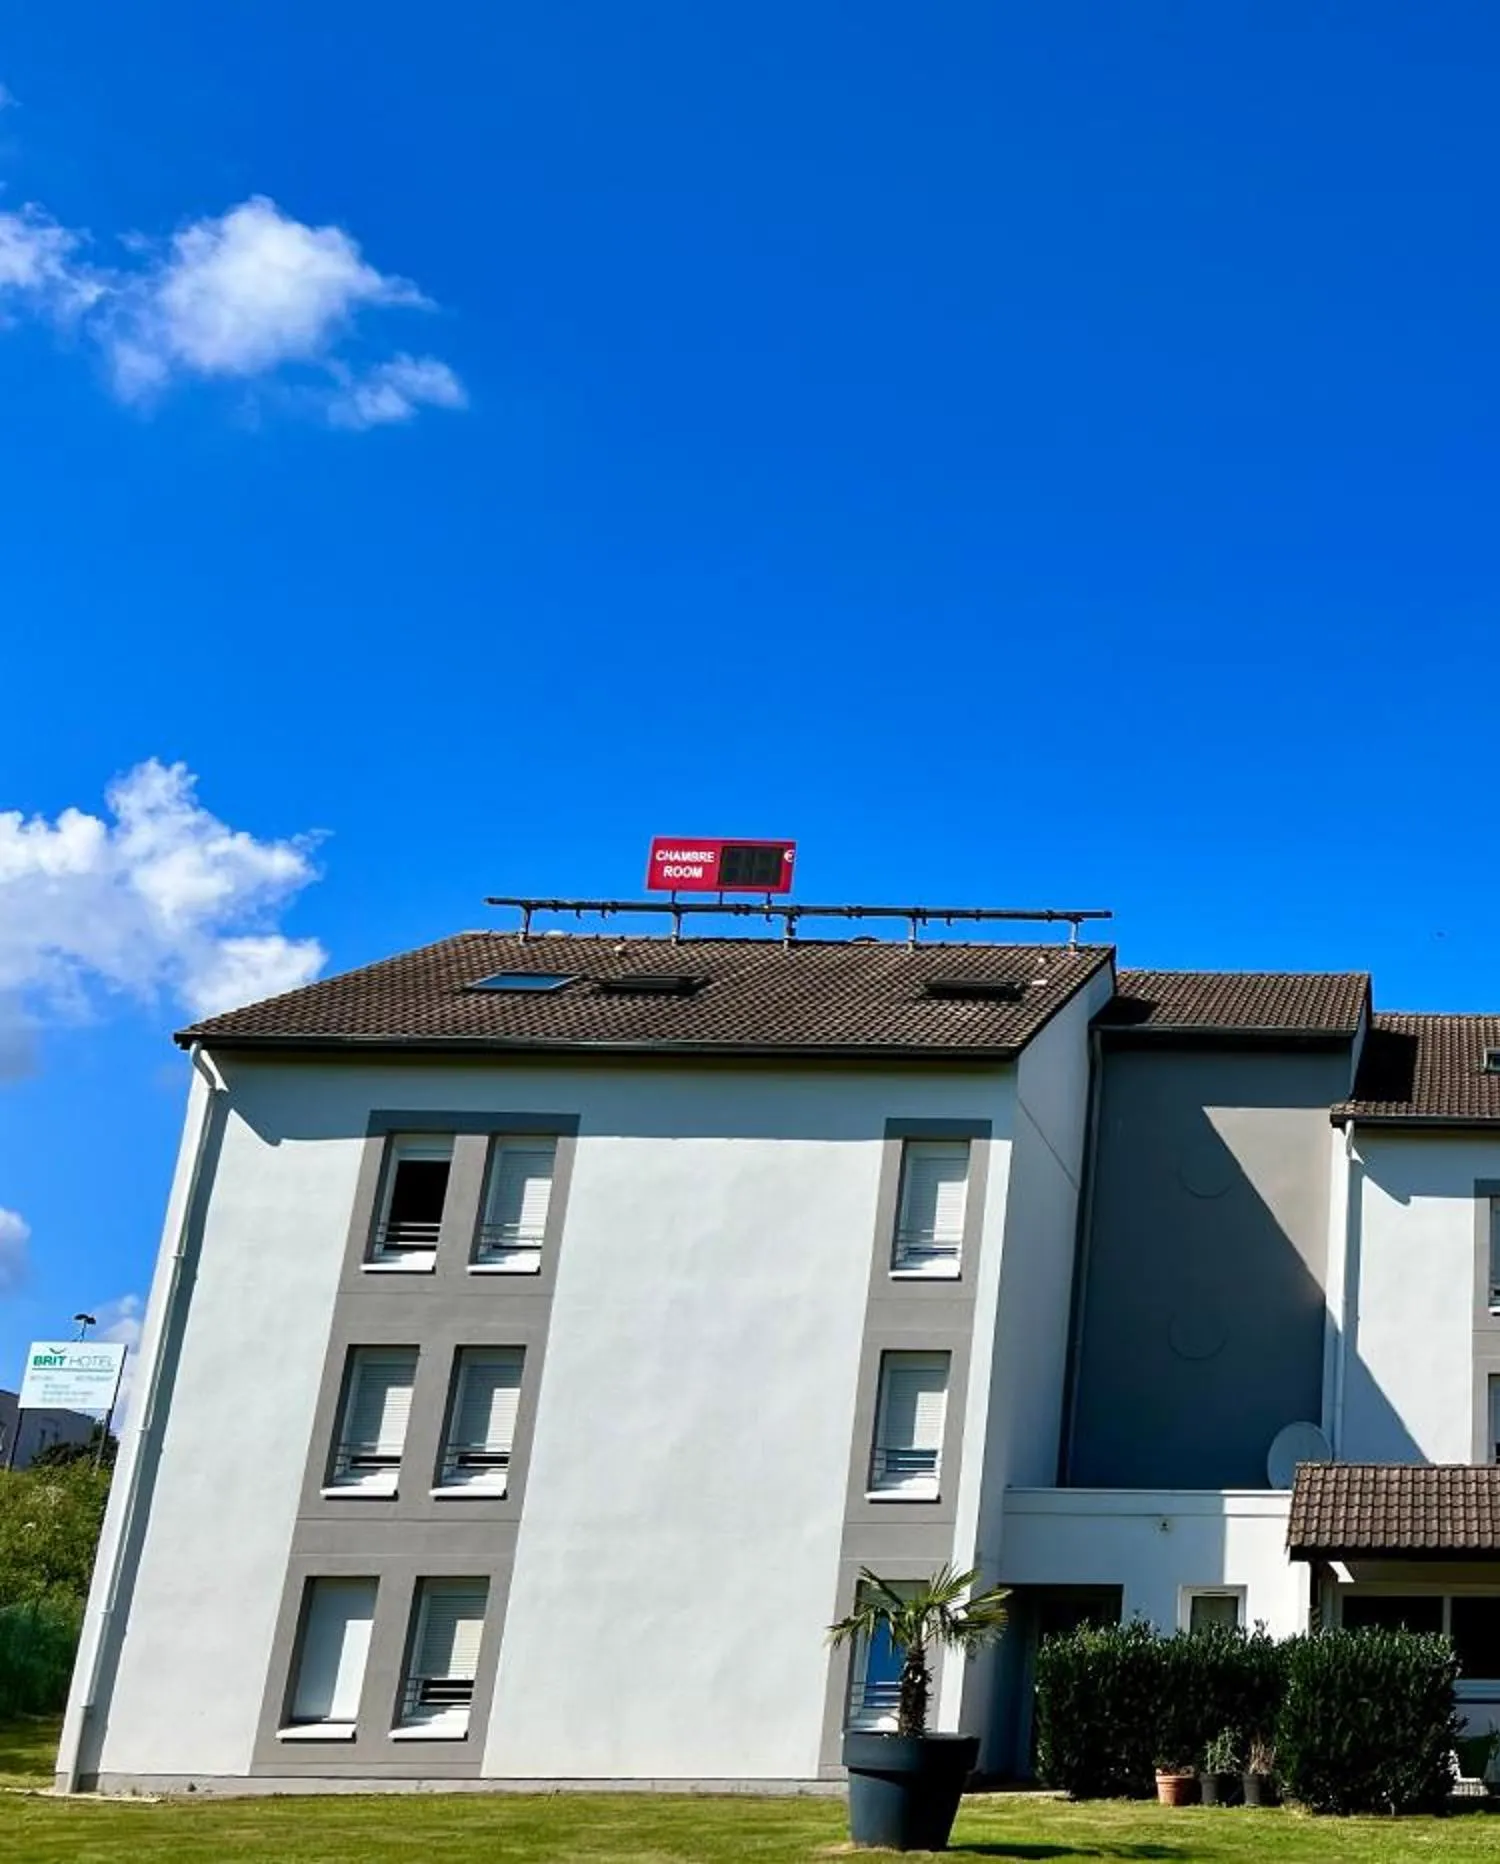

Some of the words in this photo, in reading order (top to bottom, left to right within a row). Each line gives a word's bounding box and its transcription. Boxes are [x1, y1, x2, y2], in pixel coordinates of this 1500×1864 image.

[655, 849, 714, 863] CHAMBRE
[784, 849, 796, 863] €
[663, 865, 703, 879] ROOM
[33, 1355, 67, 1366] BRIT
[69, 1355, 117, 1368] HOTEL
